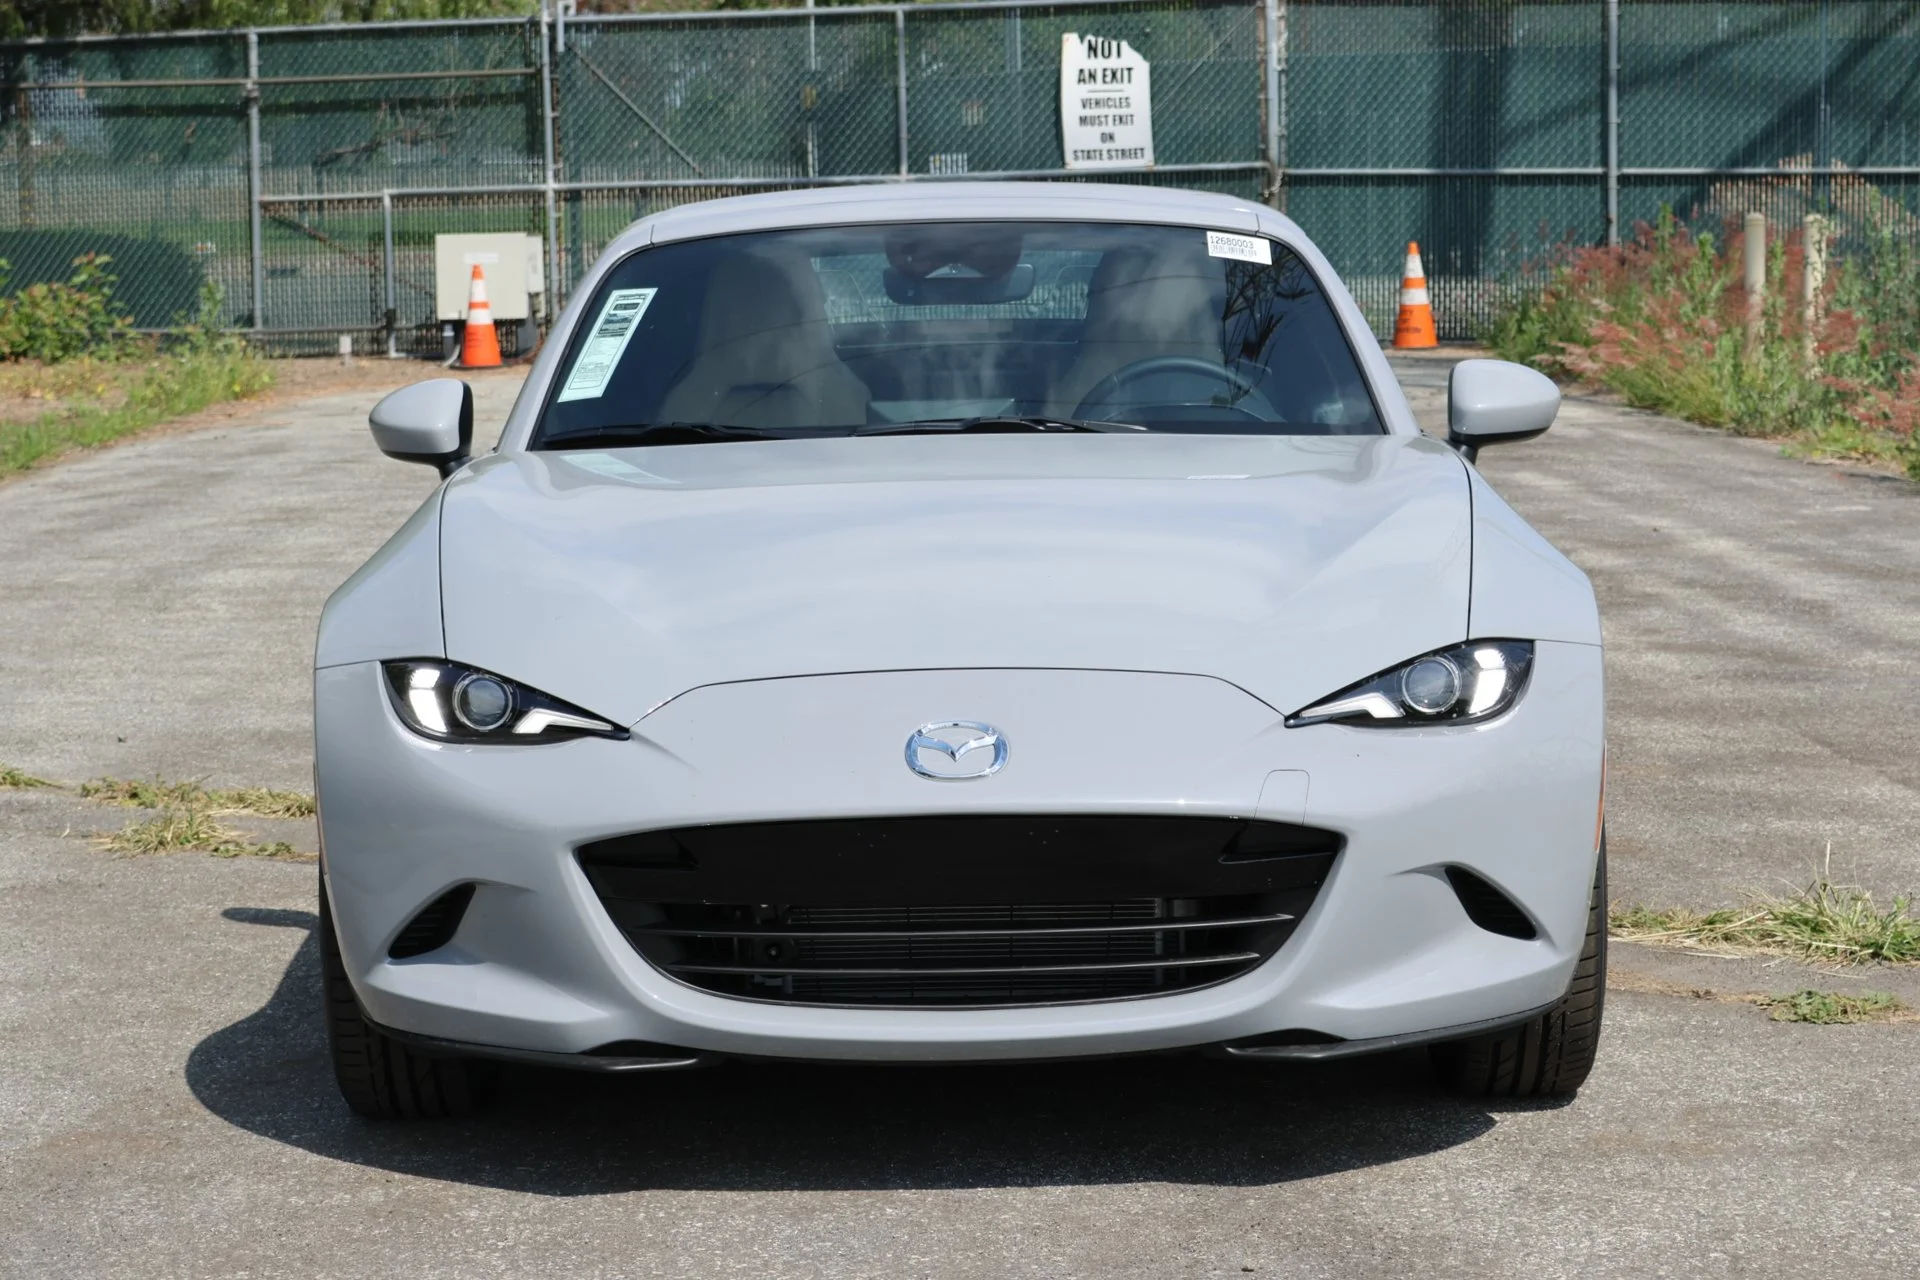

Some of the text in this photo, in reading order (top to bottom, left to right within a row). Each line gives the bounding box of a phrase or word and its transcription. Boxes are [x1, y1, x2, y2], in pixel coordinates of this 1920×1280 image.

[1077, 67, 1134, 85] AN EXIT
[1080, 96, 1131, 110] VEHICLES
[1078, 114, 1135, 127] MUST EXIT
[1100, 132, 1115, 144] ON
[1072, 147, 1145, 161] STATE STREET
[1210, 235, 1254, 249] 12680003
